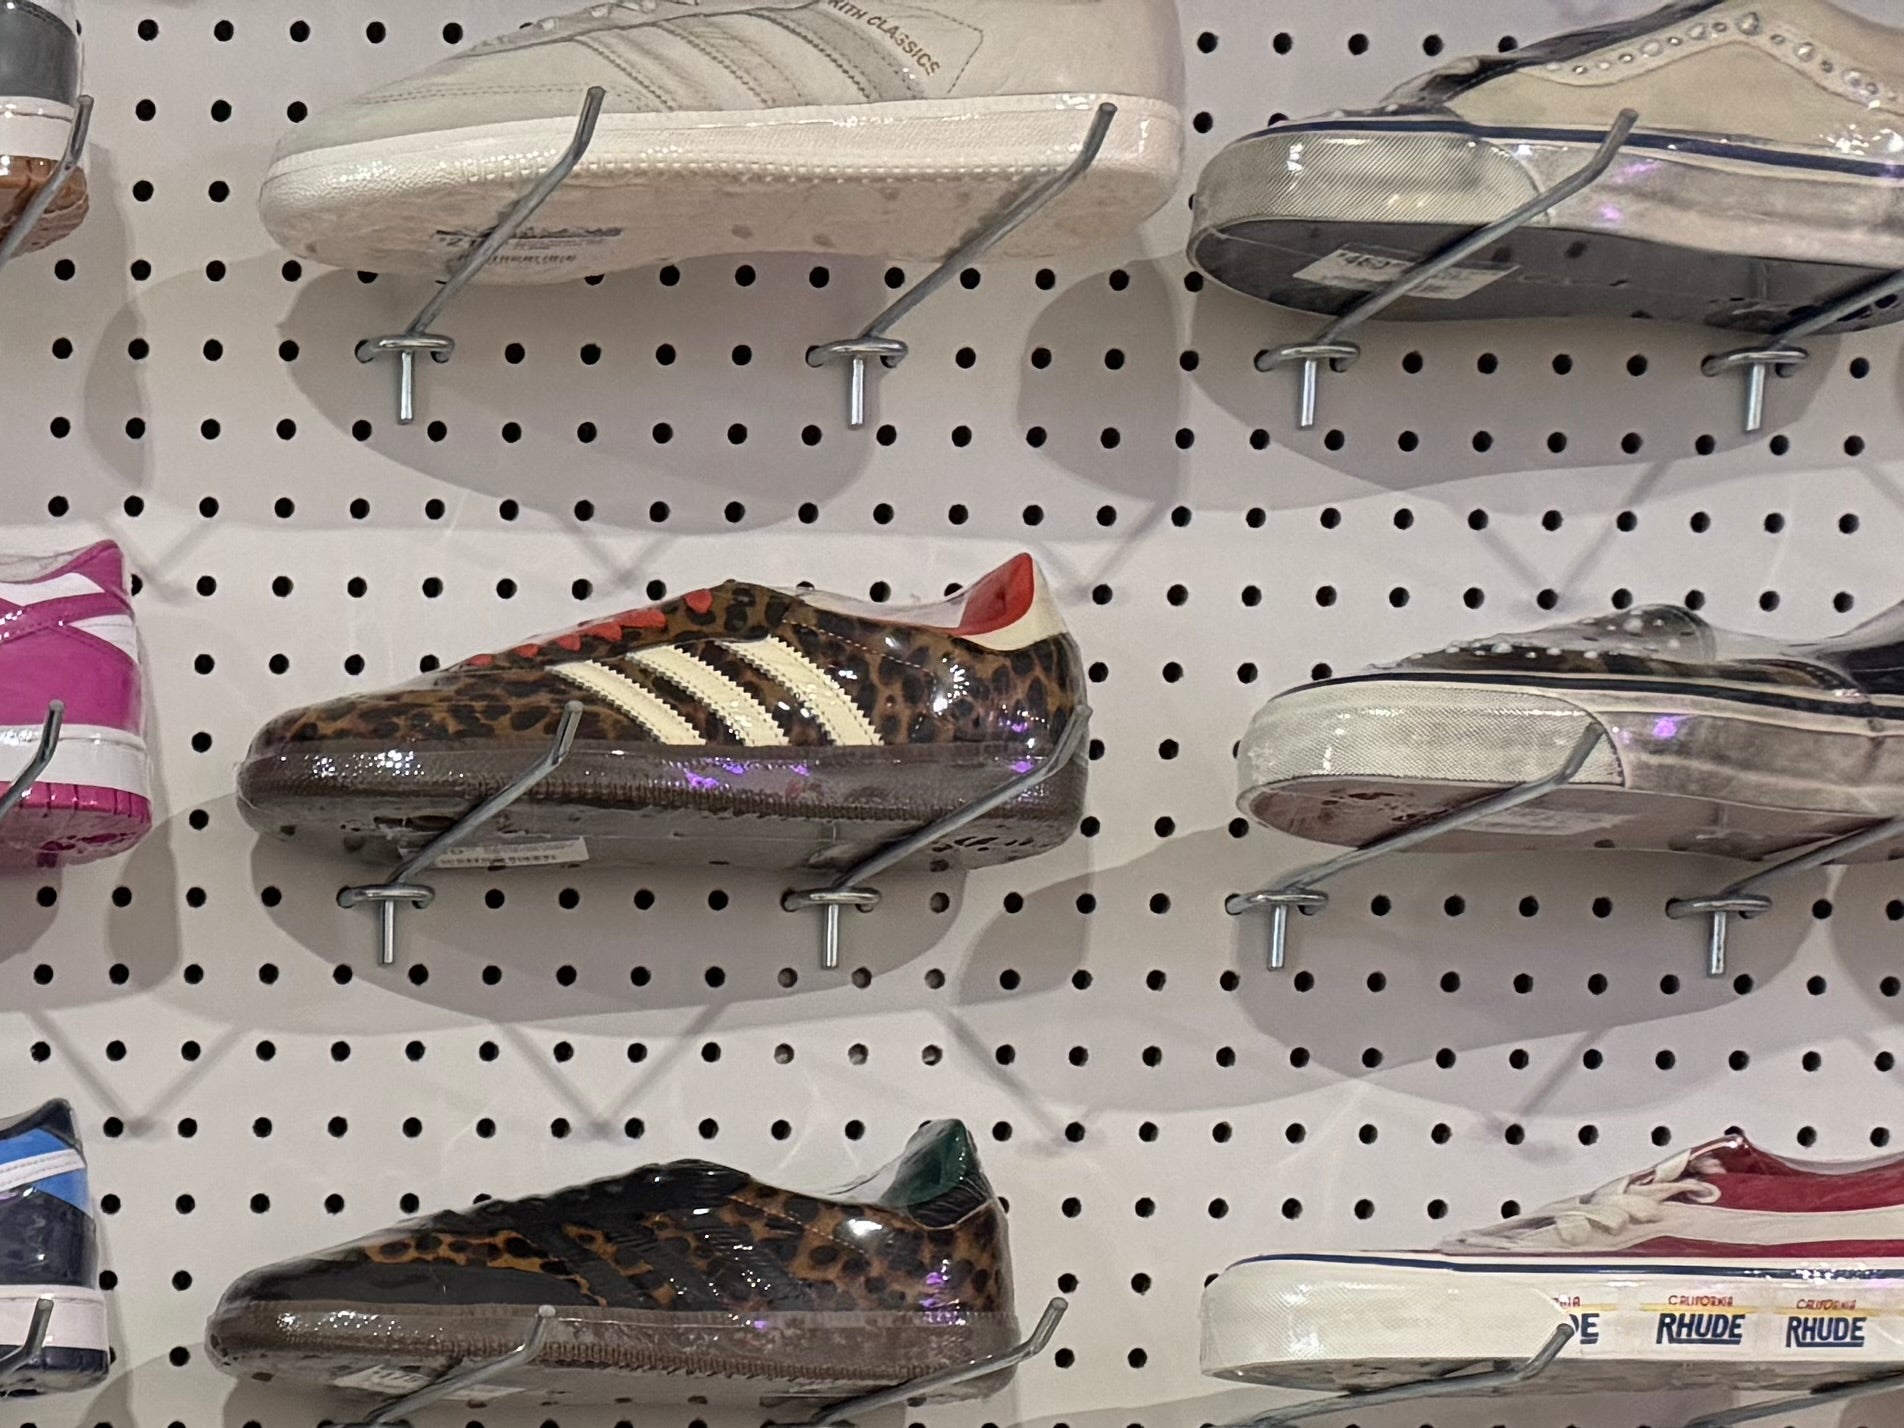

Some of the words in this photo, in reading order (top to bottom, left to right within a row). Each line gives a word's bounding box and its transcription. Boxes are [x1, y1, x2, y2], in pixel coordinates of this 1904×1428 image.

[866, 16, 942, 77] CLASSICS
[1667, 1294, 1734, 1308] CALIFORNIA
[1655, 1312, 1746, 1346] RHUDE
[1785, 1316, 1868, 1348] RHUDE
